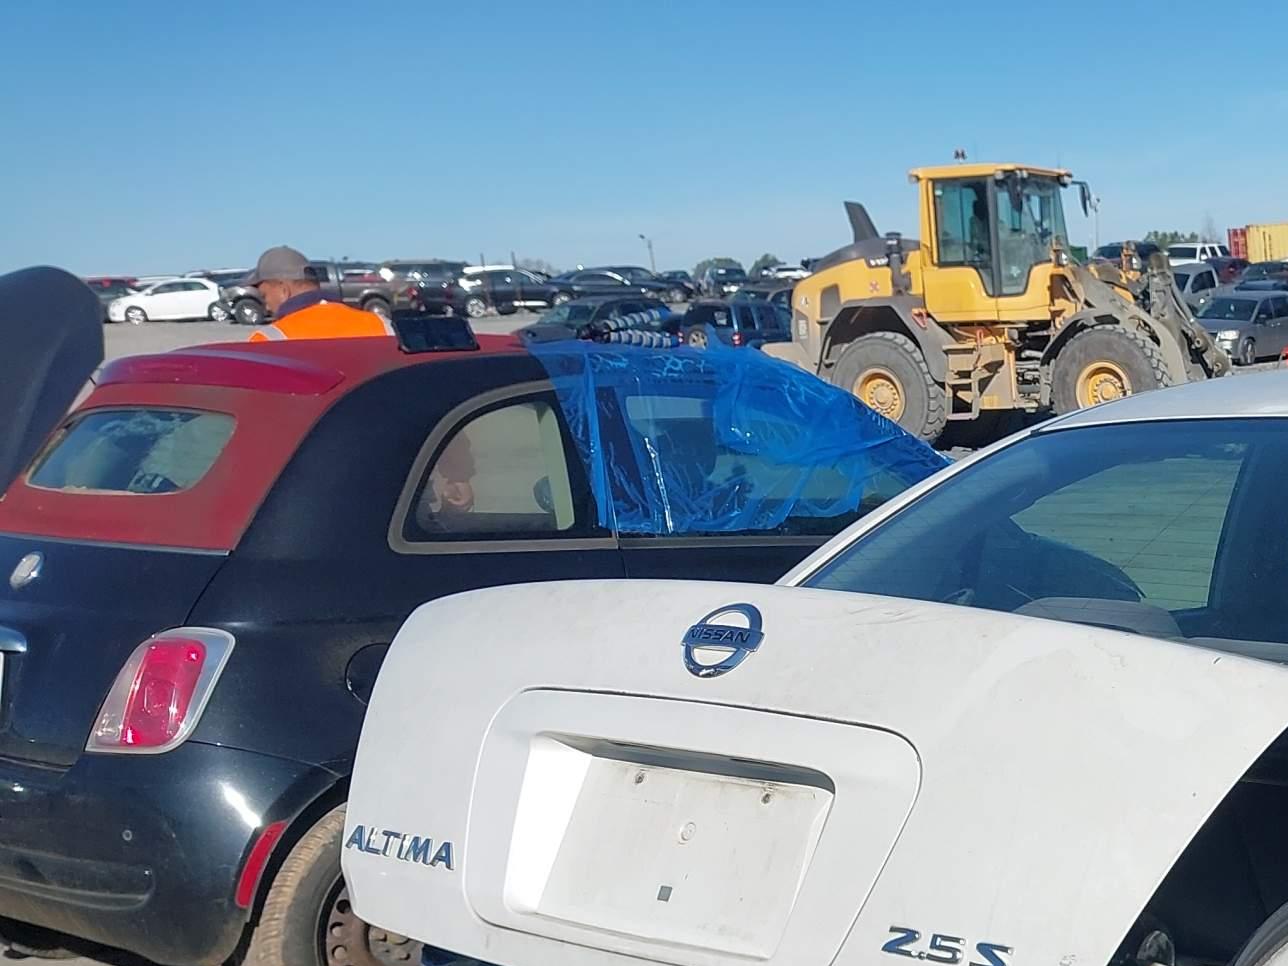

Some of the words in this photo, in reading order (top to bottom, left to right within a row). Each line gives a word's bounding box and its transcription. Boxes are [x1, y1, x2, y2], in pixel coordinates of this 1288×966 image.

[690, 627, 751, 643] NISSAN
[345, 825, 455, 870] ALTIMA
[881, 925, 966, 964] 2.5
